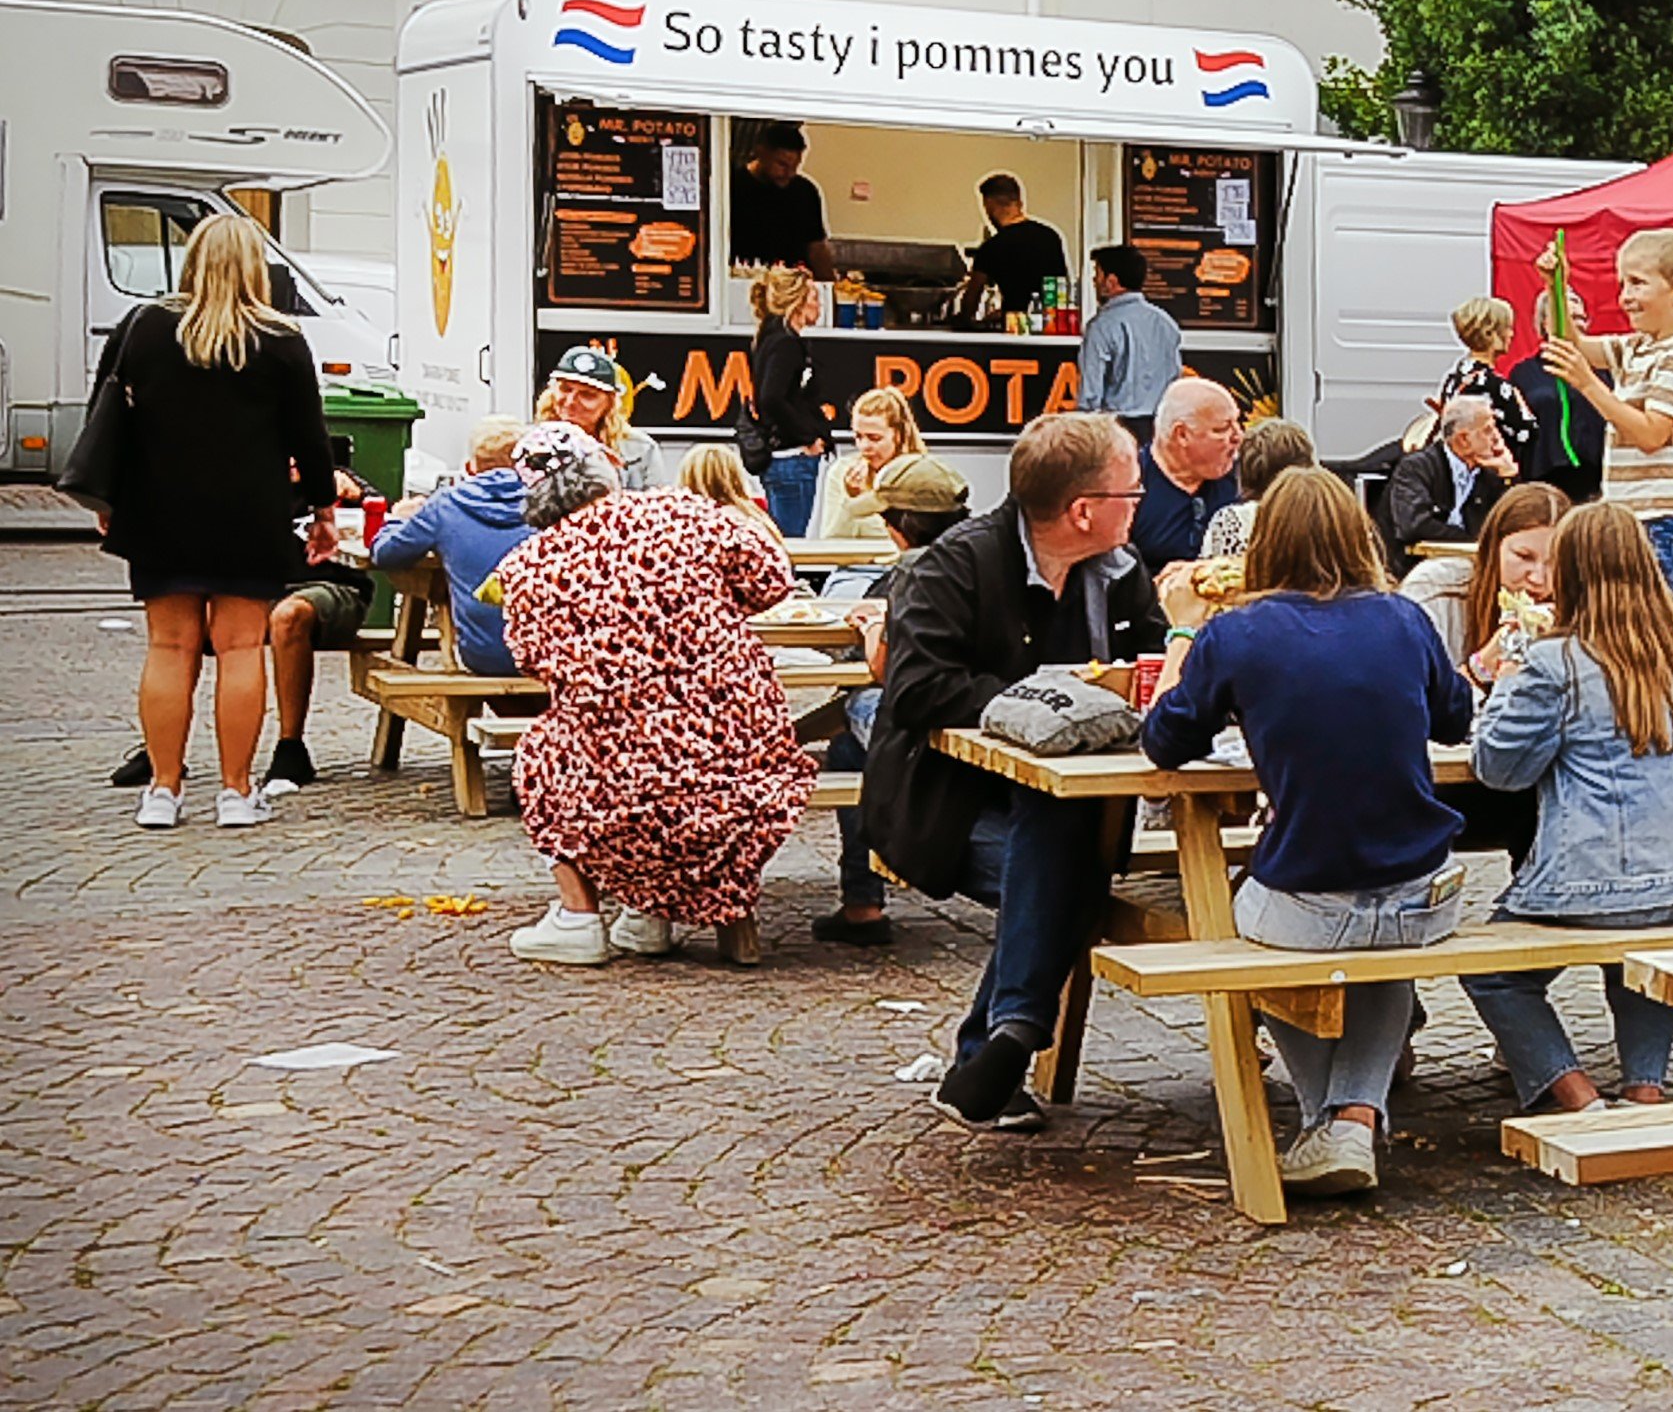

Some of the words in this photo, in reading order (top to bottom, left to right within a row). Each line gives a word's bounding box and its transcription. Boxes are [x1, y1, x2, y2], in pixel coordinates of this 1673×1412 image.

[663, 11, 723, 54] So
[739, 18, 853, 75] tasty
[870, 25, 879, 66] i
[896, 37, 1083, 80] pommes
[1097, 53, 1175, 93] you
